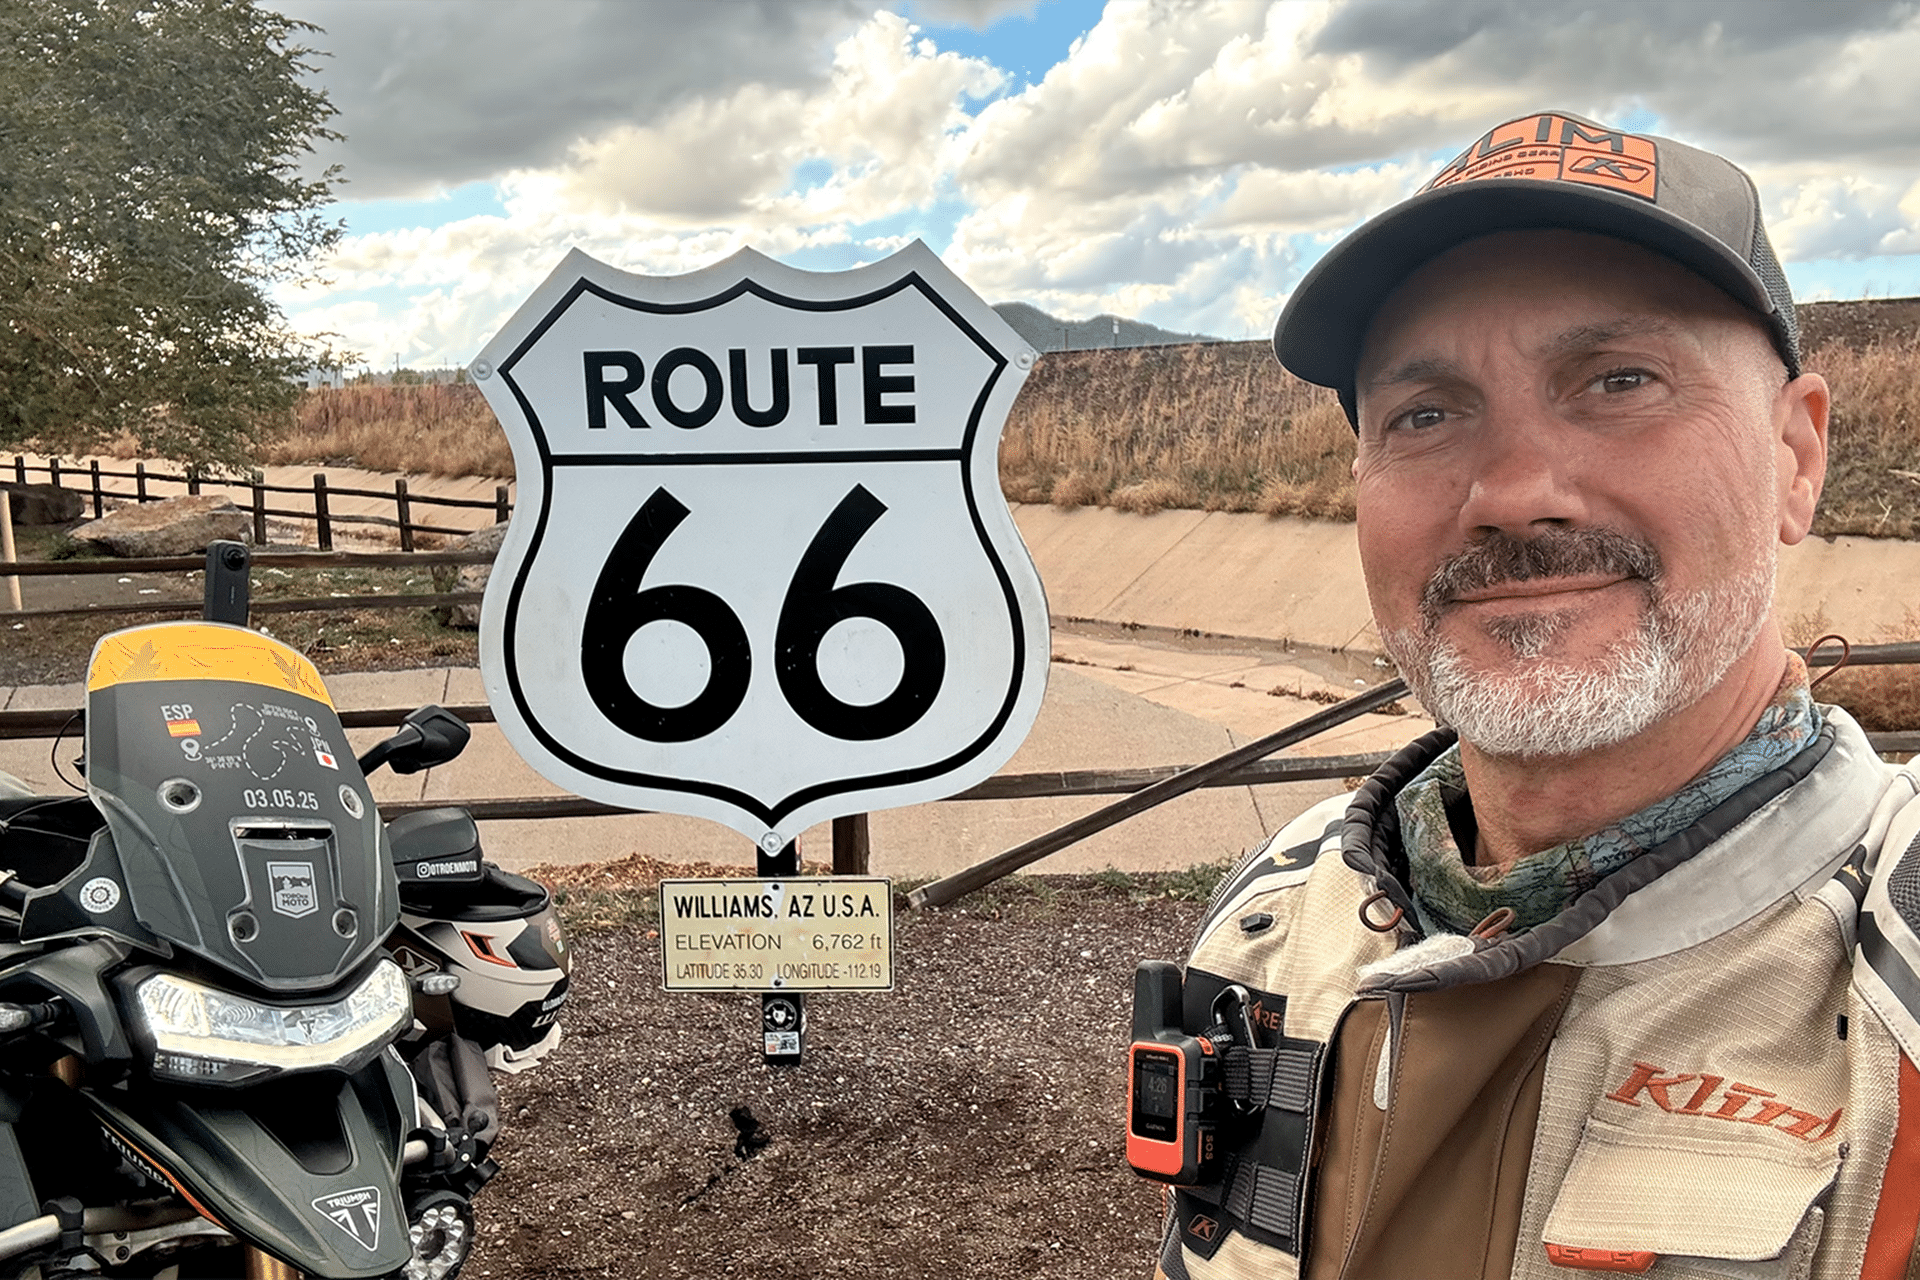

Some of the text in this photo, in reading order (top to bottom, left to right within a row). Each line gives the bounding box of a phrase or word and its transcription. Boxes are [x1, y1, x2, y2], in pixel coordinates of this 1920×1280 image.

[582, 344, 916, 430] ROUTE
[580, 482, 947, 744] 66
[160, 704, 194, 722] ESP
[310, 735, 332, 754] JPN
[243, 788, 319, 811] 03.05.25
[281, 898, 310, 907] MOTO
[788, 894, 815, 918] AZ
[823, 894, 880, 918] U.S.A.
[675, 932, 882, 952] ELEVATION 6,762 ft
[676, 962, 730, 980] LATITUDE
[732, 963, 764, 980] 35.30
[776, 962, 841, 980] LONGITUDE
[1605, 1061, 1844, 1143] Klim
[1205, 1134, 1214, 1160] SOS
[100, 1125, 176, 1195] TRIUMPH
[326, 1191, 372, 1209] TRIUMPH
